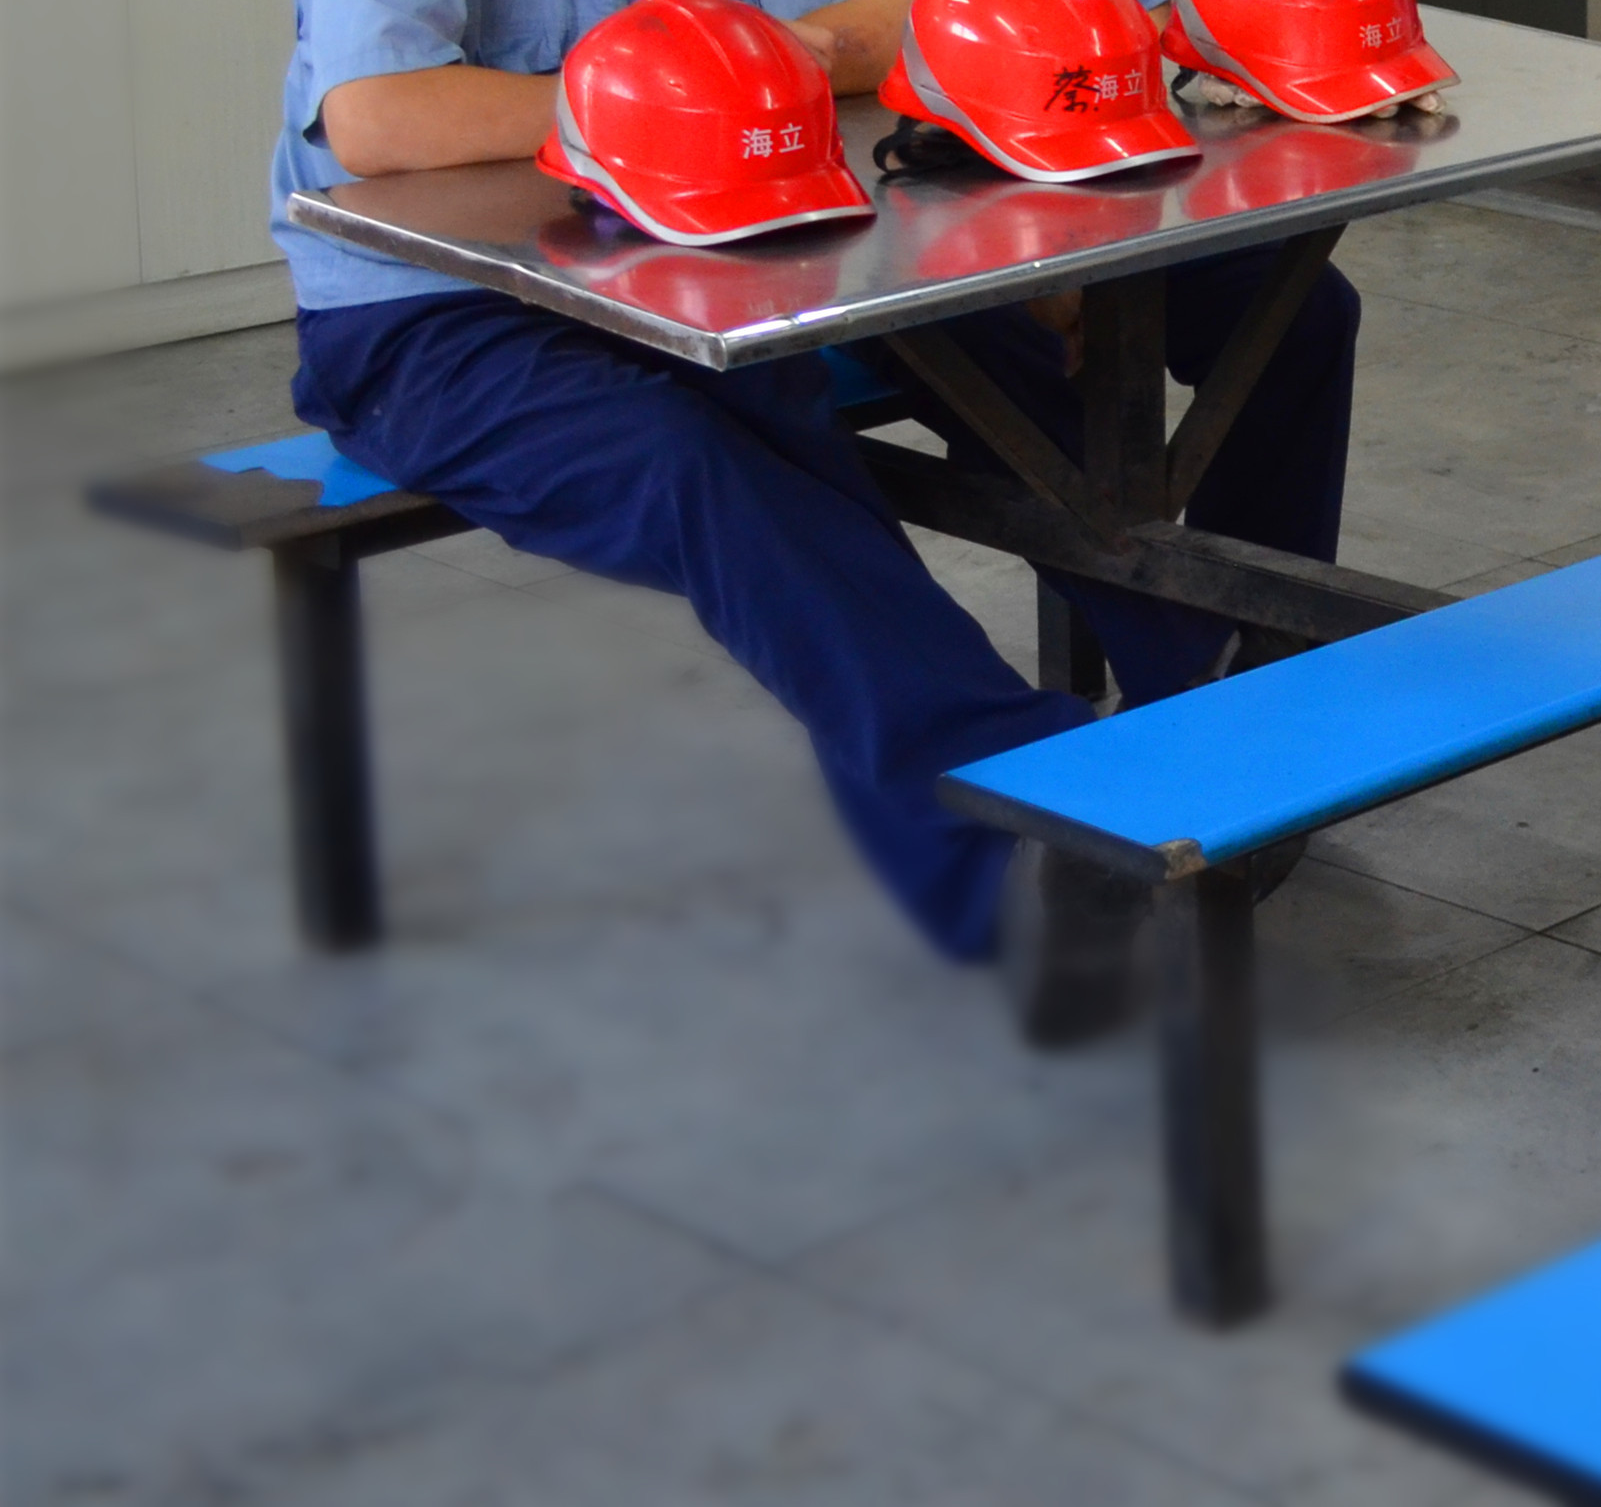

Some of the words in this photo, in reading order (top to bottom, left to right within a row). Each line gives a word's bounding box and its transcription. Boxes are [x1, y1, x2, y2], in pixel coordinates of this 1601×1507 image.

[1359, 17, 1402, 48] 海立
[1093, 69, 1143, 103] 海立
[742, 123, 805, 159] 海立
